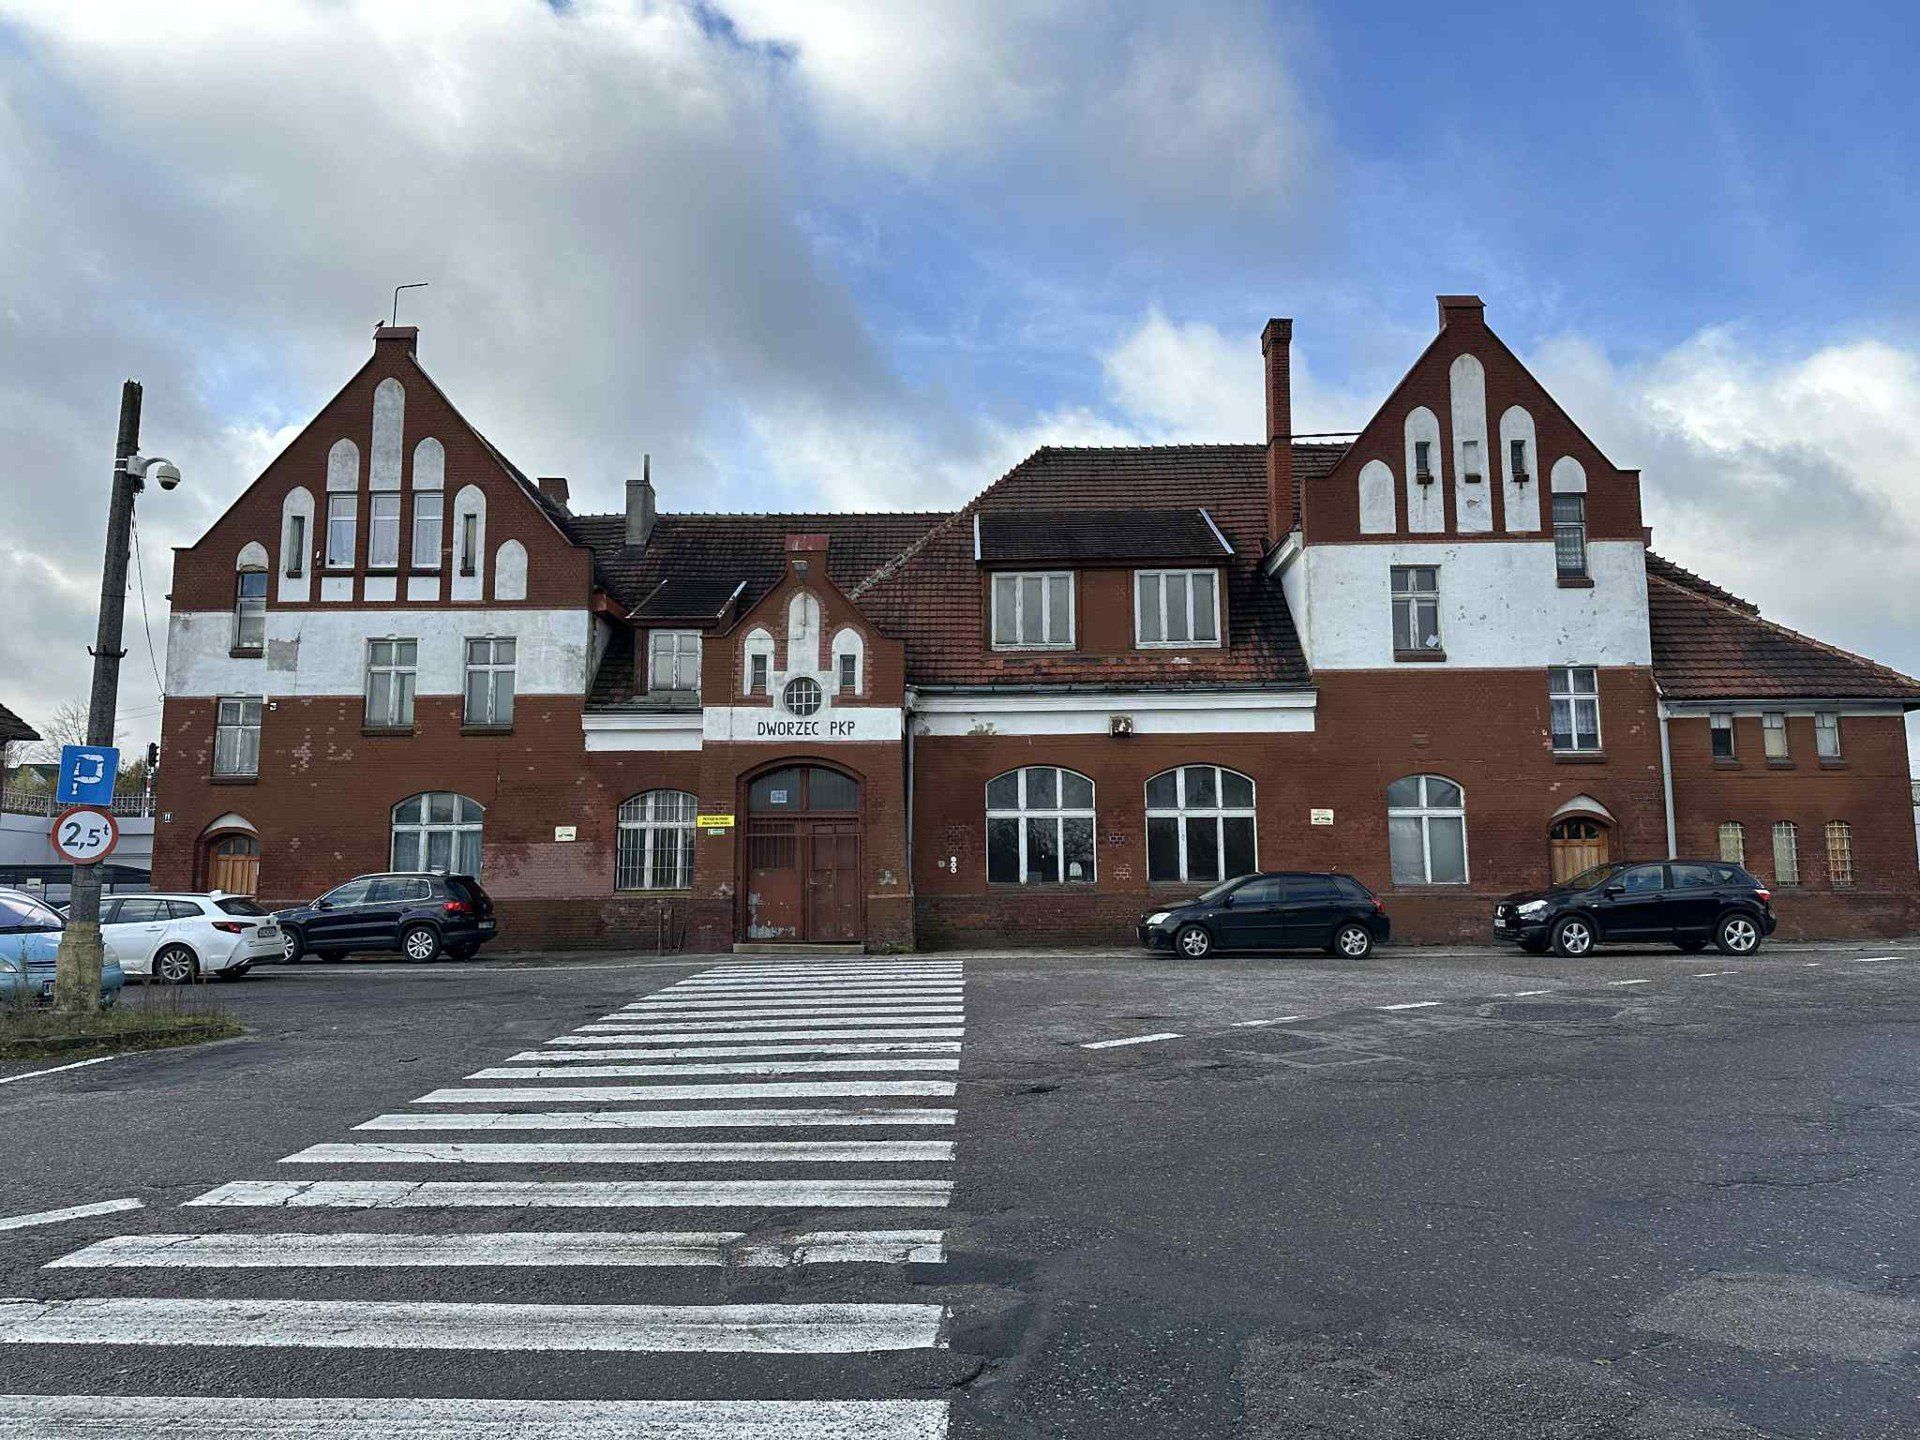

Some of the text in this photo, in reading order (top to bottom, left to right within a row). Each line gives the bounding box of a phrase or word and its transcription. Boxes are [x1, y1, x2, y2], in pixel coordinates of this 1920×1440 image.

[757, 721, 855, 736] DWORZEC PKP
[72, 754, 104, 796] P
